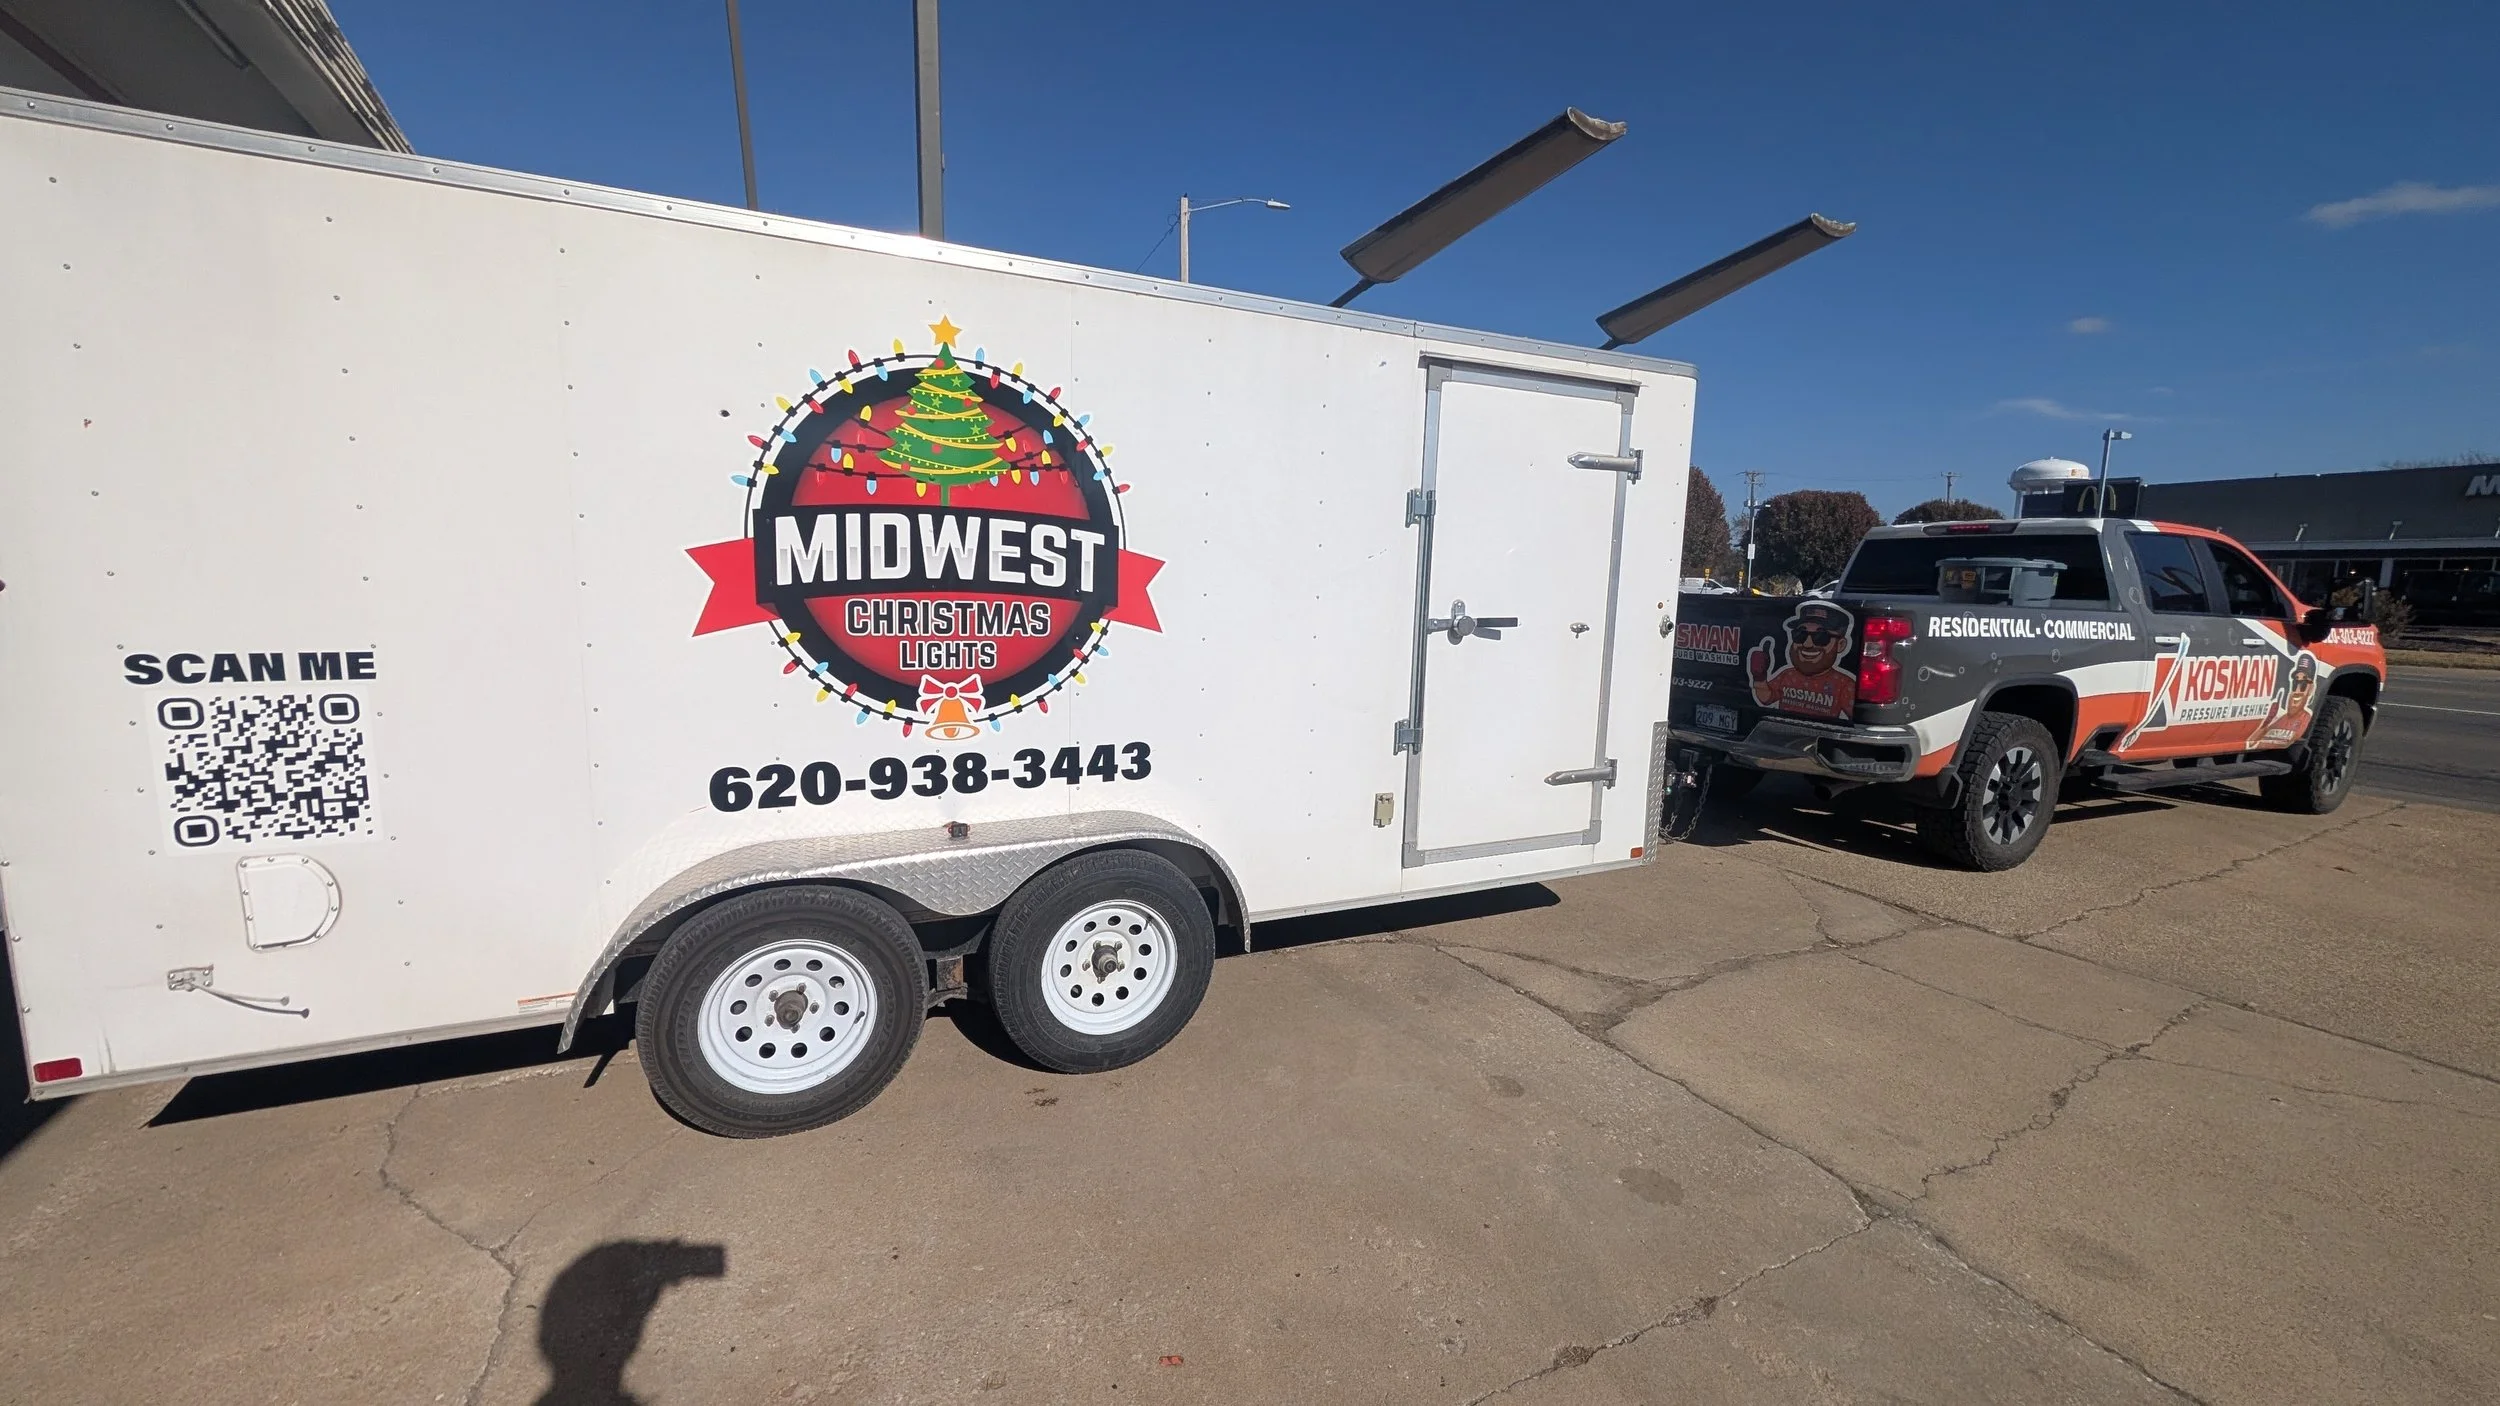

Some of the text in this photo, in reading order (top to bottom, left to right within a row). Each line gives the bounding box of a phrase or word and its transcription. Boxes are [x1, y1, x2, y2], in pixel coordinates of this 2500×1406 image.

[775, 512, 1105, 593] MIDWEST
[846, 600, 1050, 636] CHRISTMAS
[1928, 616, 2136, 641] RESIDENTIAL COMMERCIAL
[1675, 623, 1741, 653] SMAN
[123, 651, 377, 686] SCAN ME
[900, 641, 996, 669] LIGHTS
[1696, 649, 1740, 666] WASHING
[1672, 677, 1713, 692] 03-9227
[2184, 656, 2277, 702] KOSMAN
[1782, 686, 1834, 707] KOSMAN
[2180, 703, 2269, 721] PRESSURE WASHING
[709, 741, 1152, 812] 620-938-3443
